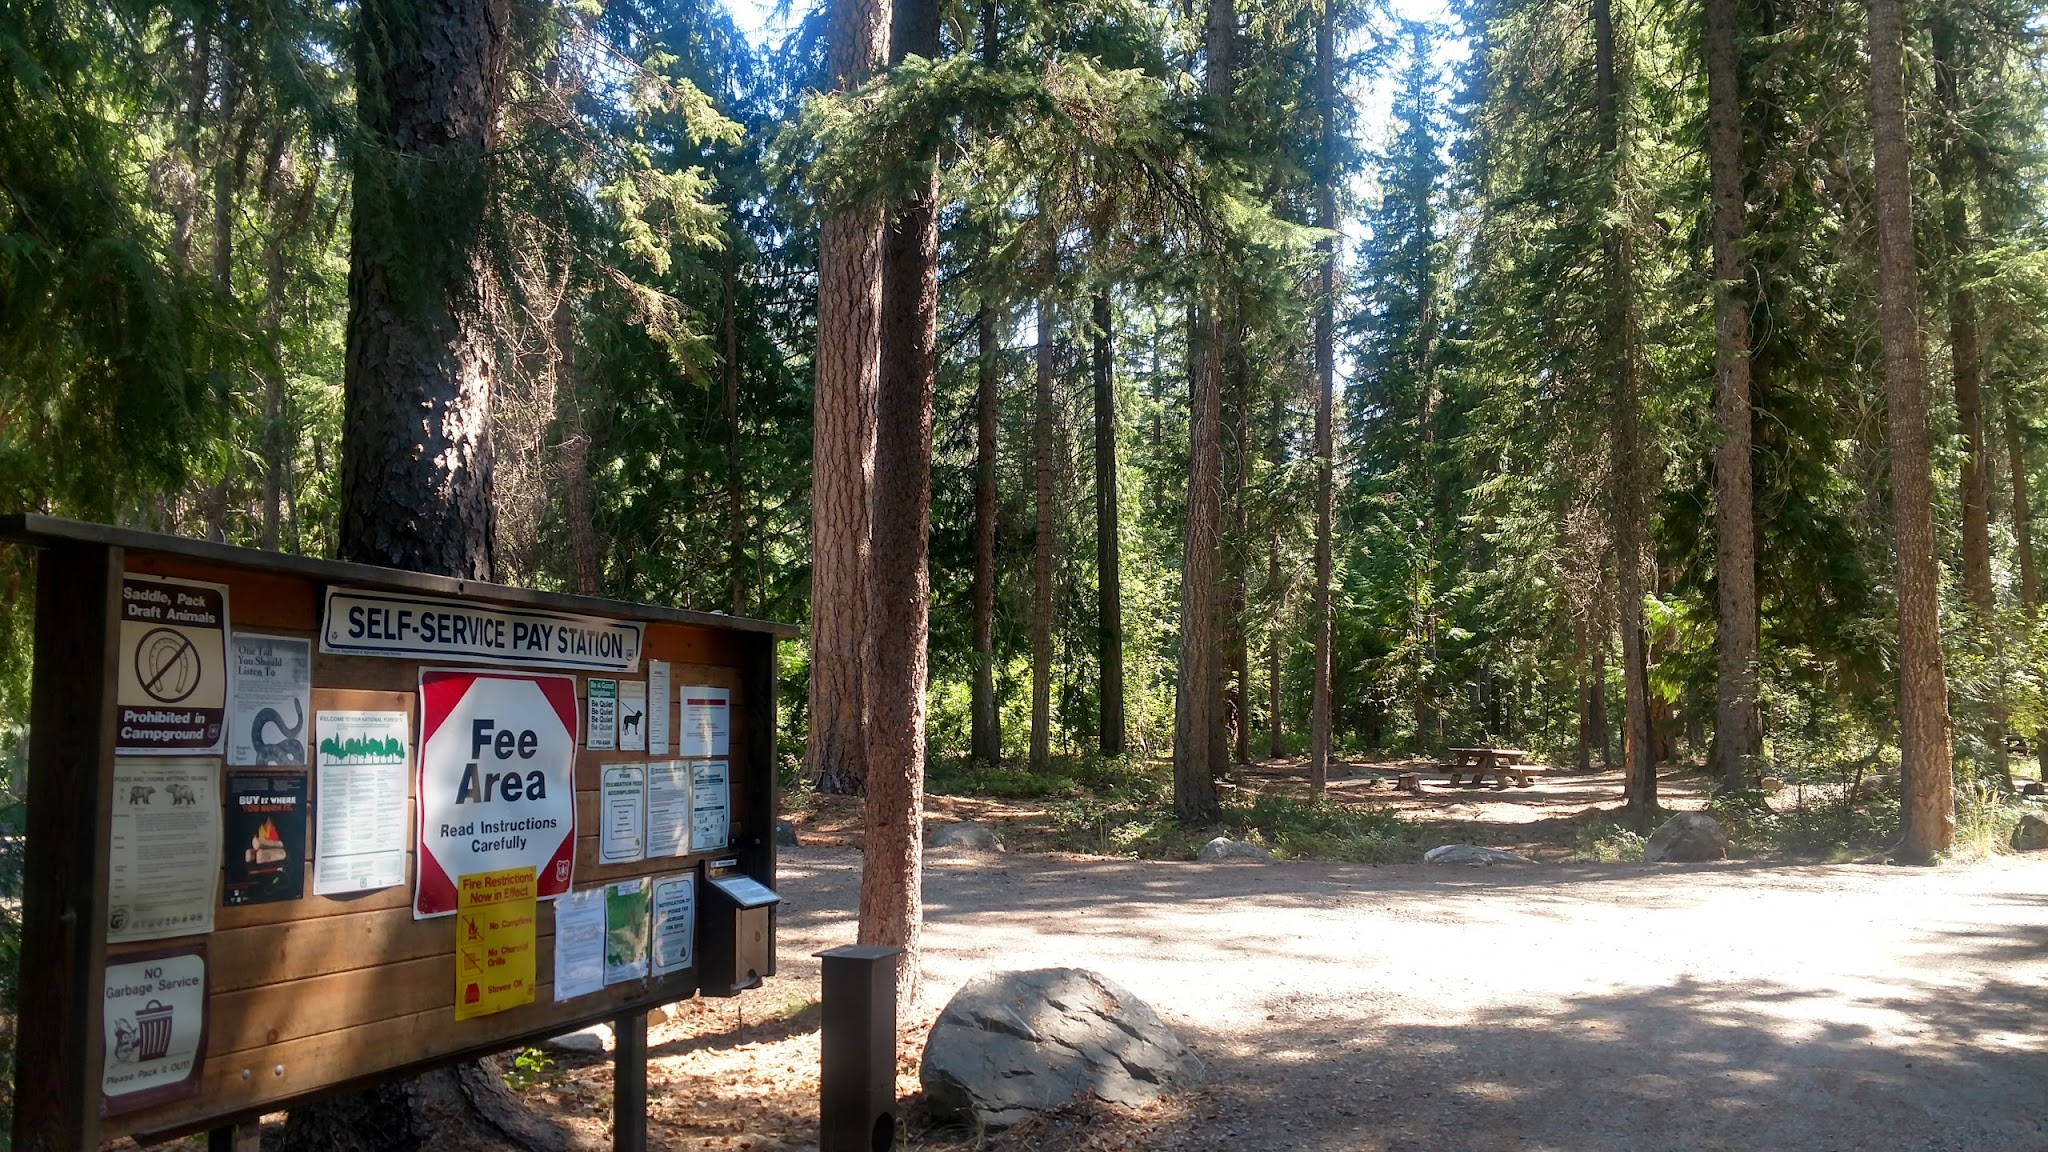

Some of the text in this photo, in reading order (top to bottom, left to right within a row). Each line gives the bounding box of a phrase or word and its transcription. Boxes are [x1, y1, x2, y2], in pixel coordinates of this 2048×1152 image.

[123, 586, 206, 607] Saddle, Pack
[128, 604, 216, 624] Draft Animals
[348, 606, 622, 658] SELF-SERVICE PAY STATION
[239, 646, 272, 656] One Tail
[238, 656, 282, 666] You Should
[238, 666, 276, 676] Listen To
[600, 700, 613, 708] Quiet
[124, 710, 206, 724] Prohibited in
[121, 726, 204, 741] Campground
[472, 719, 538, 760] Fee
[455, 763, 546, 804] Area
[239, 796, 260, 805] BUY
[270, 796, 296, 804] WHERE
[440, 817, 557, 838] Read Instructions
[472, 836, 526, 852] Carefully
[462, 872, 534, 890] Fire Restrictions
[470, 886, 528, 904] Now in Effect
[659, 899, 685, 908] NOTIFICATION
[490, 922, 498, 930] No
[488, 949, 498, 957] No
[488, 958, 505, 967] Grills
[144, 967, 162, 980] NO
[106, 976, 199, 999] Garbage Service
[488, 979, 523, 994] Stoves OK
[106, 1074, 134, 1085] Please
[138, 1068, 157, 1078] Pack
